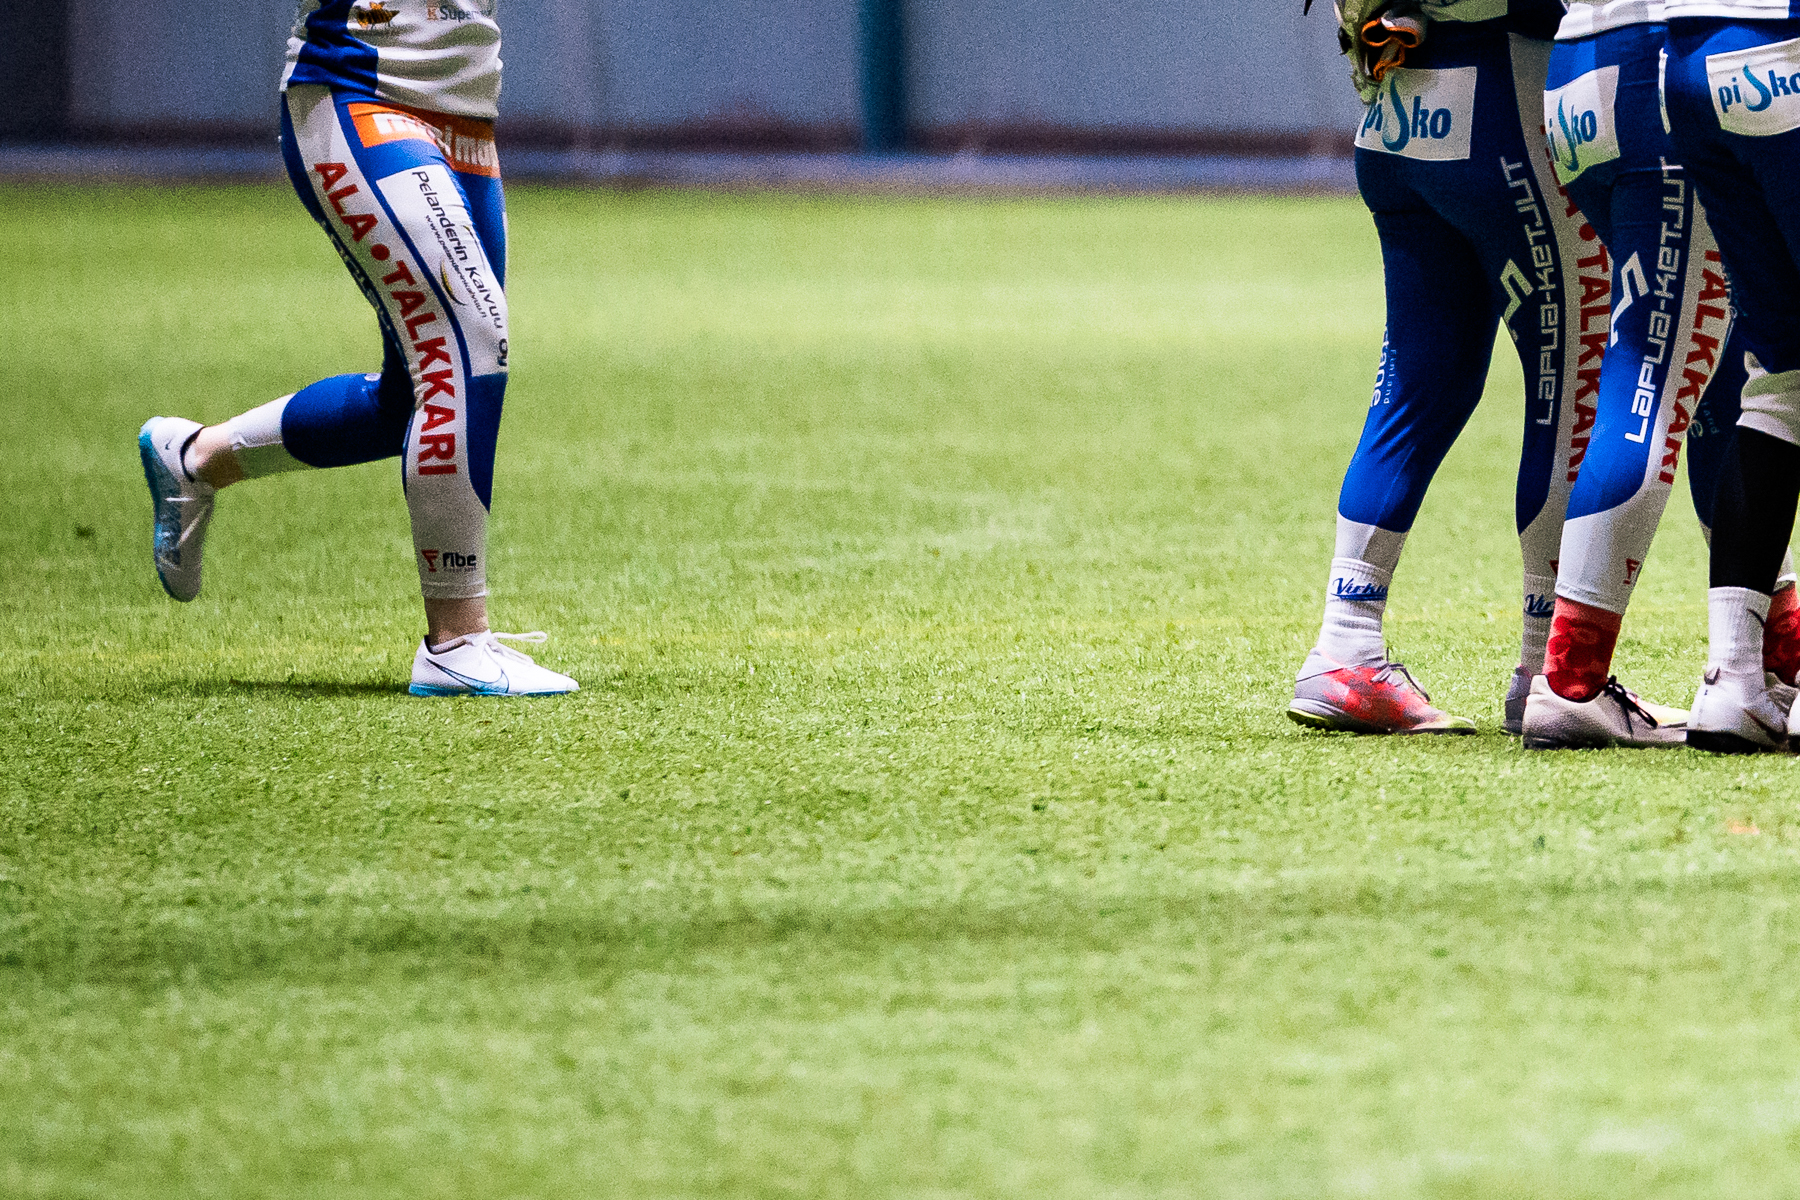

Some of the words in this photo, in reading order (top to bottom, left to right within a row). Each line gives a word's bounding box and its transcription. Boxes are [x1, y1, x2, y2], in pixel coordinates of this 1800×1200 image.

[314, 162, 379, 243] ALA
[382, 260, 458, 476] TALKKARI
[411, 170, 469, 262] Pelanderin
[464, 265, 503, 330] Kaivuu
